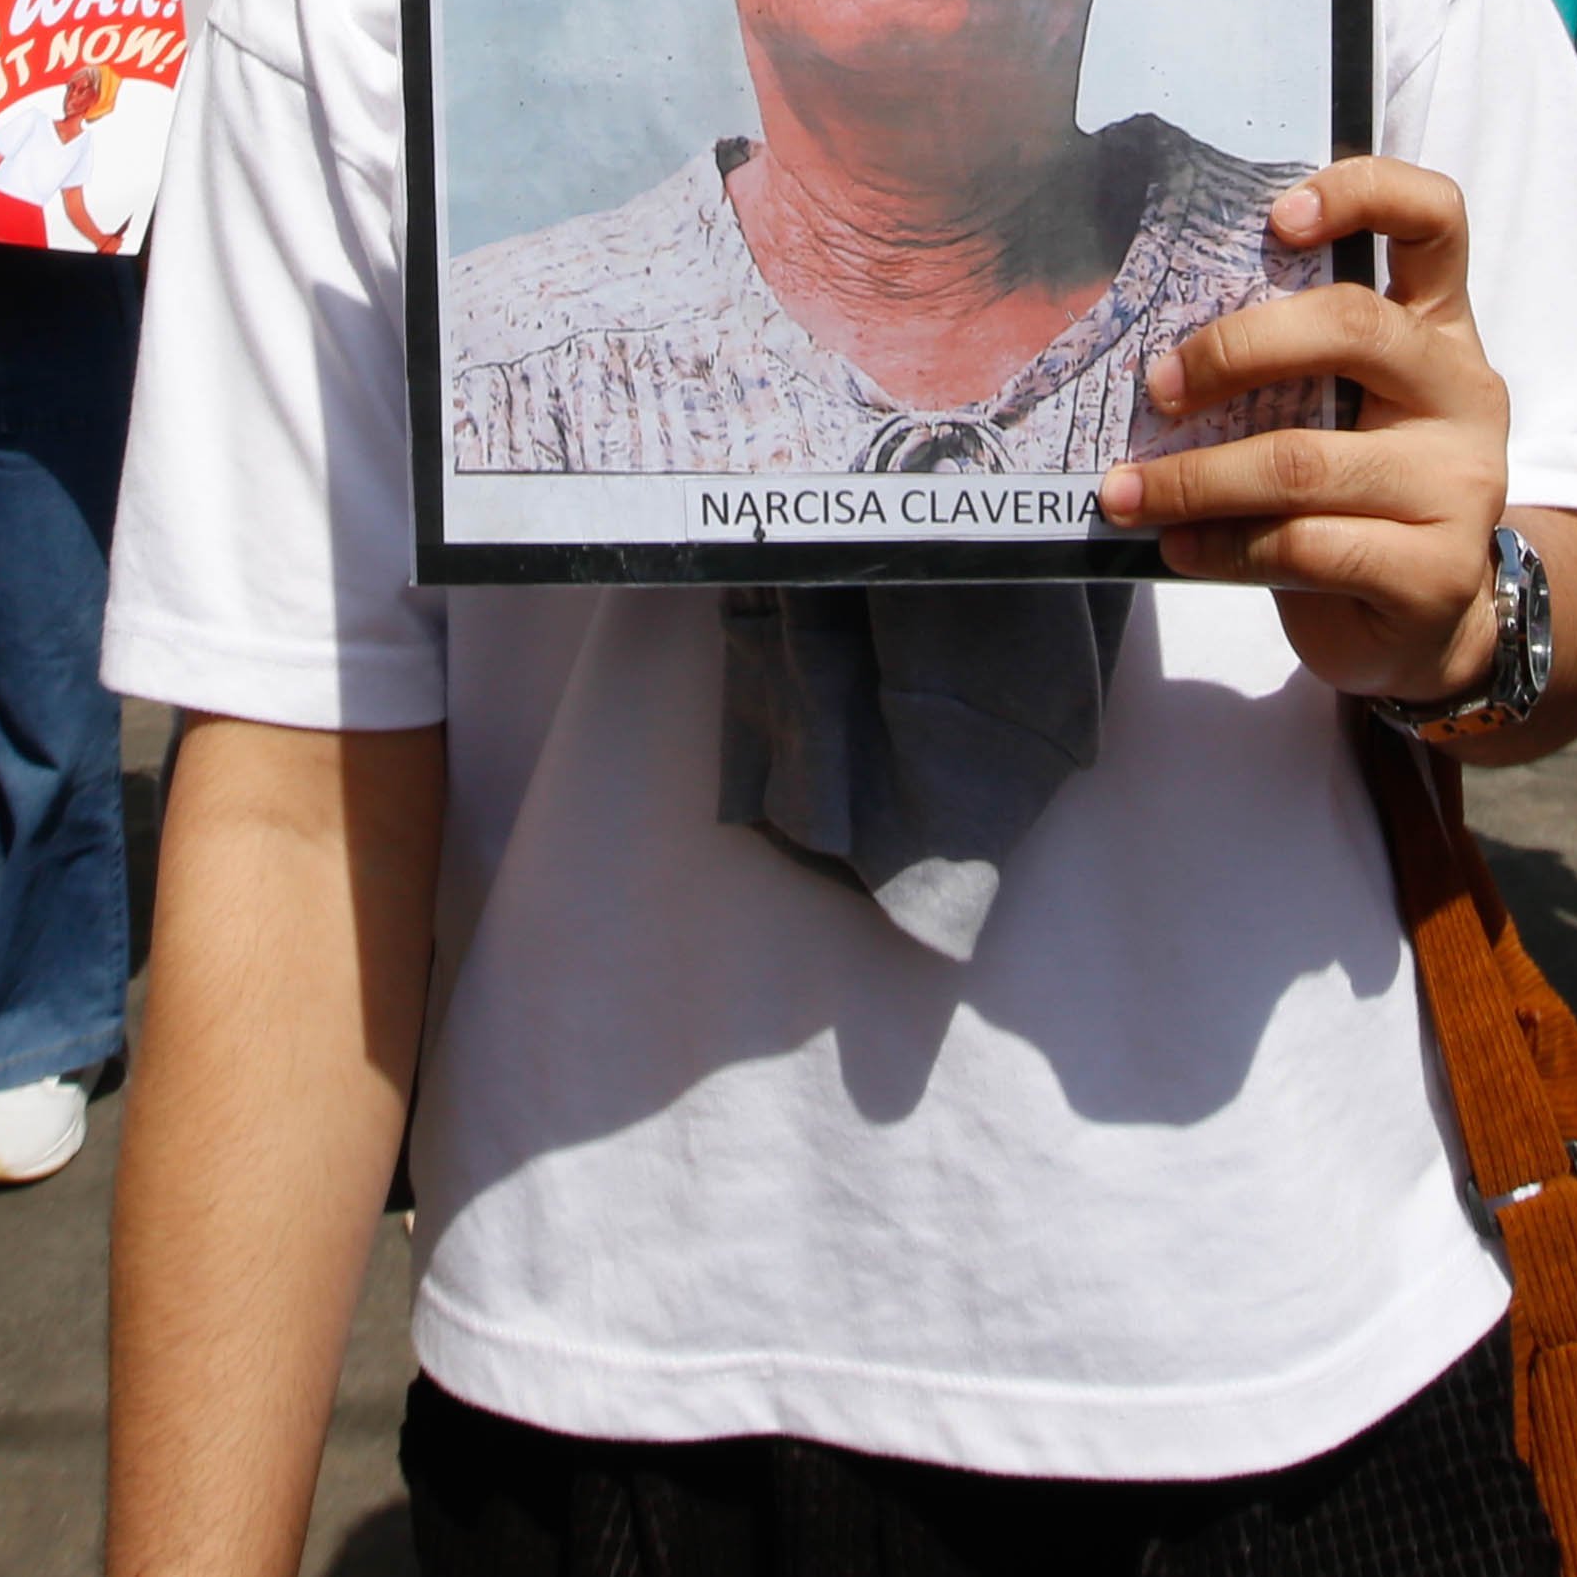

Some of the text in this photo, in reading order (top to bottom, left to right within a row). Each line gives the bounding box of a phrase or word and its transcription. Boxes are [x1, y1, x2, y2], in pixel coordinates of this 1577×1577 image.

[47, 23, 188, 79] NOW!
[701, 489, 1101, 525] NARCISA CLAVERIA
